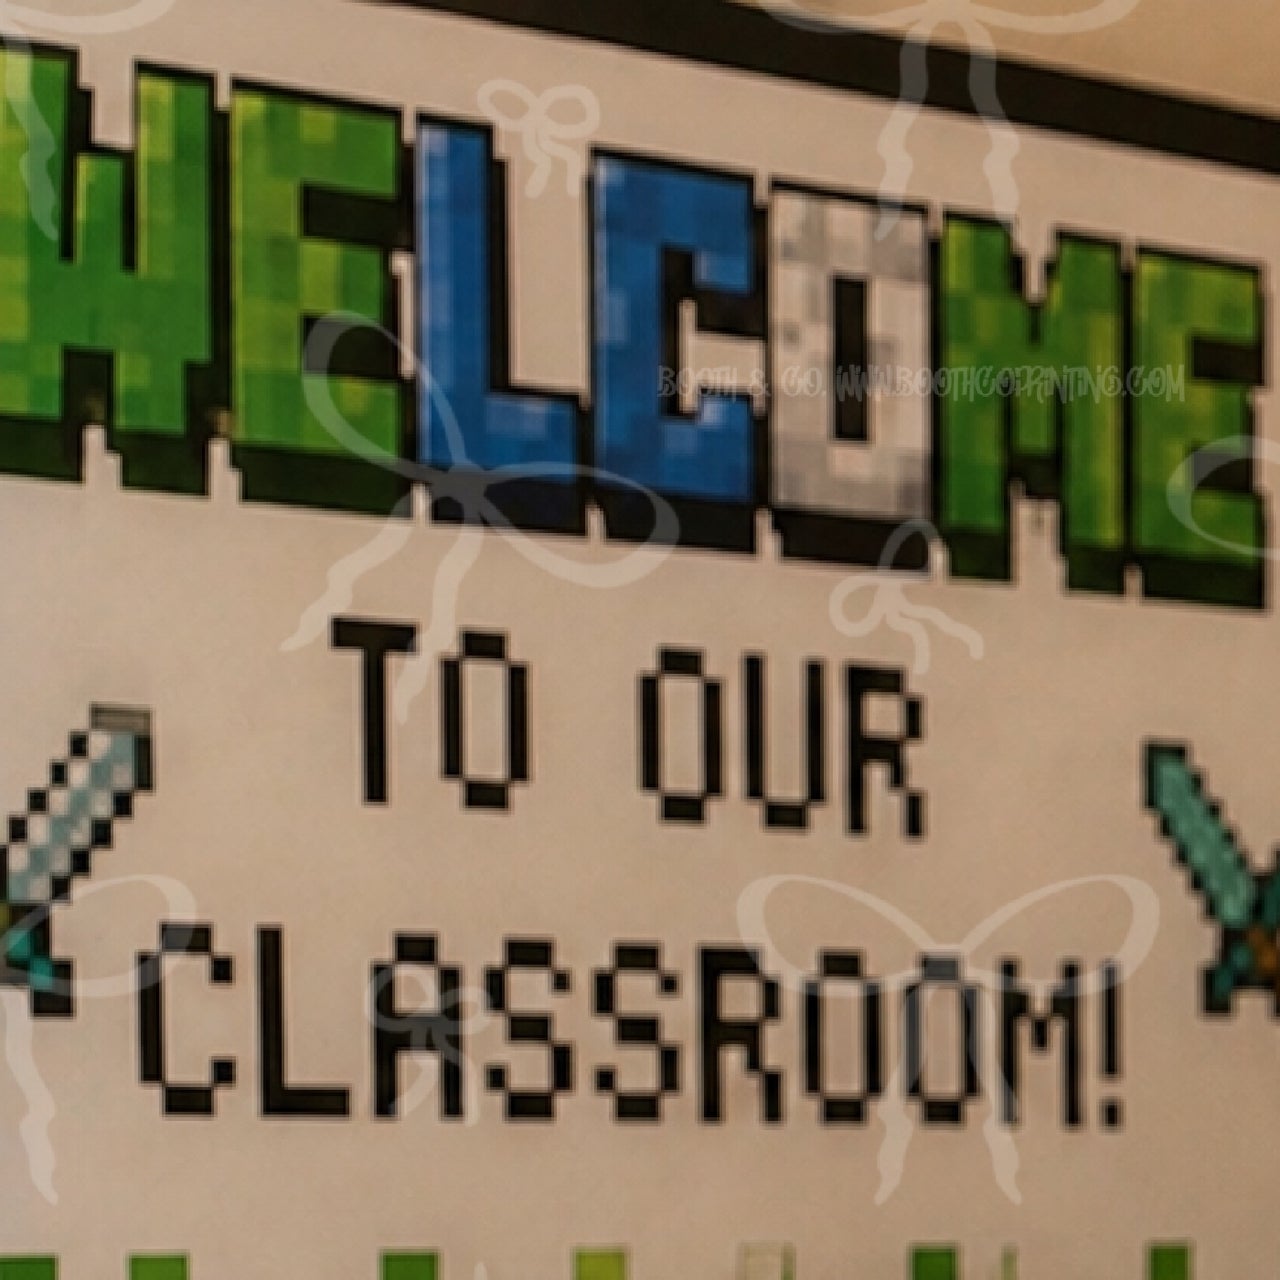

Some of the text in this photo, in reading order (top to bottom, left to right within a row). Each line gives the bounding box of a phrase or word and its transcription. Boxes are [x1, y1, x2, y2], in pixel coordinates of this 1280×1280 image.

[0, 36, 1268, 610] WELCOME
[331, 616, 925, 839] TO OUR
[135, 921, 1122, 1129] CLASSROOM!
